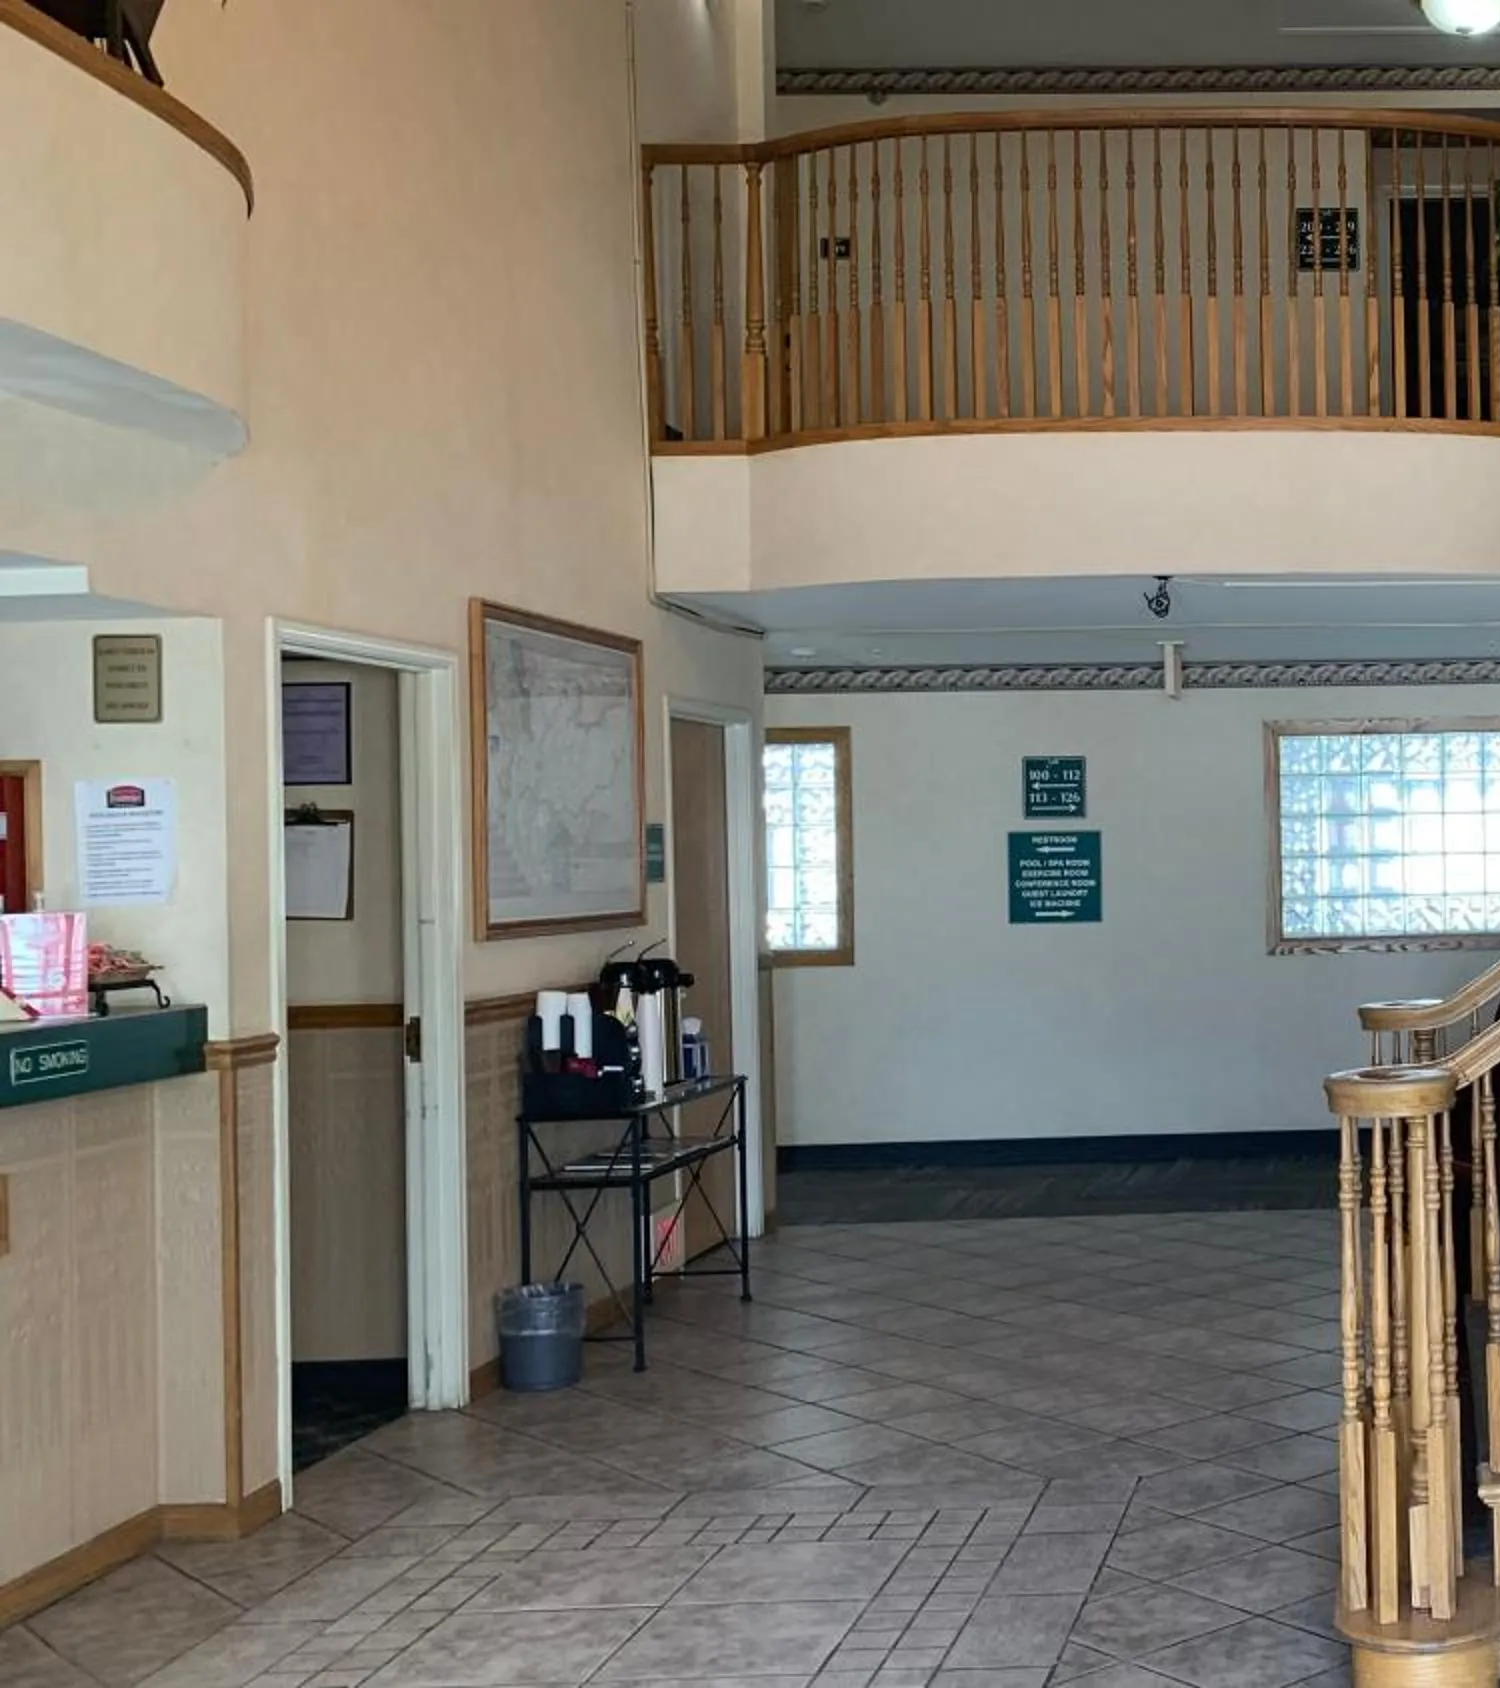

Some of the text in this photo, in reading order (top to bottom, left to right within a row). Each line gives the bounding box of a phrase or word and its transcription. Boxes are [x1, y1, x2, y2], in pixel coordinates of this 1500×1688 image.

[1062, 769, 1080, 780] 112
[1032, 836, 1077, 844] RESTROOM
[1020, 860, 1043, 868] POOL
[1048, 859, 1064, 867] SPA
[1066, 859, 1090, 867] ROOM
[1022, 869, 1088, 878] EXERCISE ROOM
[1015, 879, 1096, 888] CONFERENCE ROOM
[1022, 889, 1088, 898] GUEST LAUNDRY
[1029, 899, 1081, 908] ICE MACHINE
[15, 1048, 88, 1073] NO SMOKING
